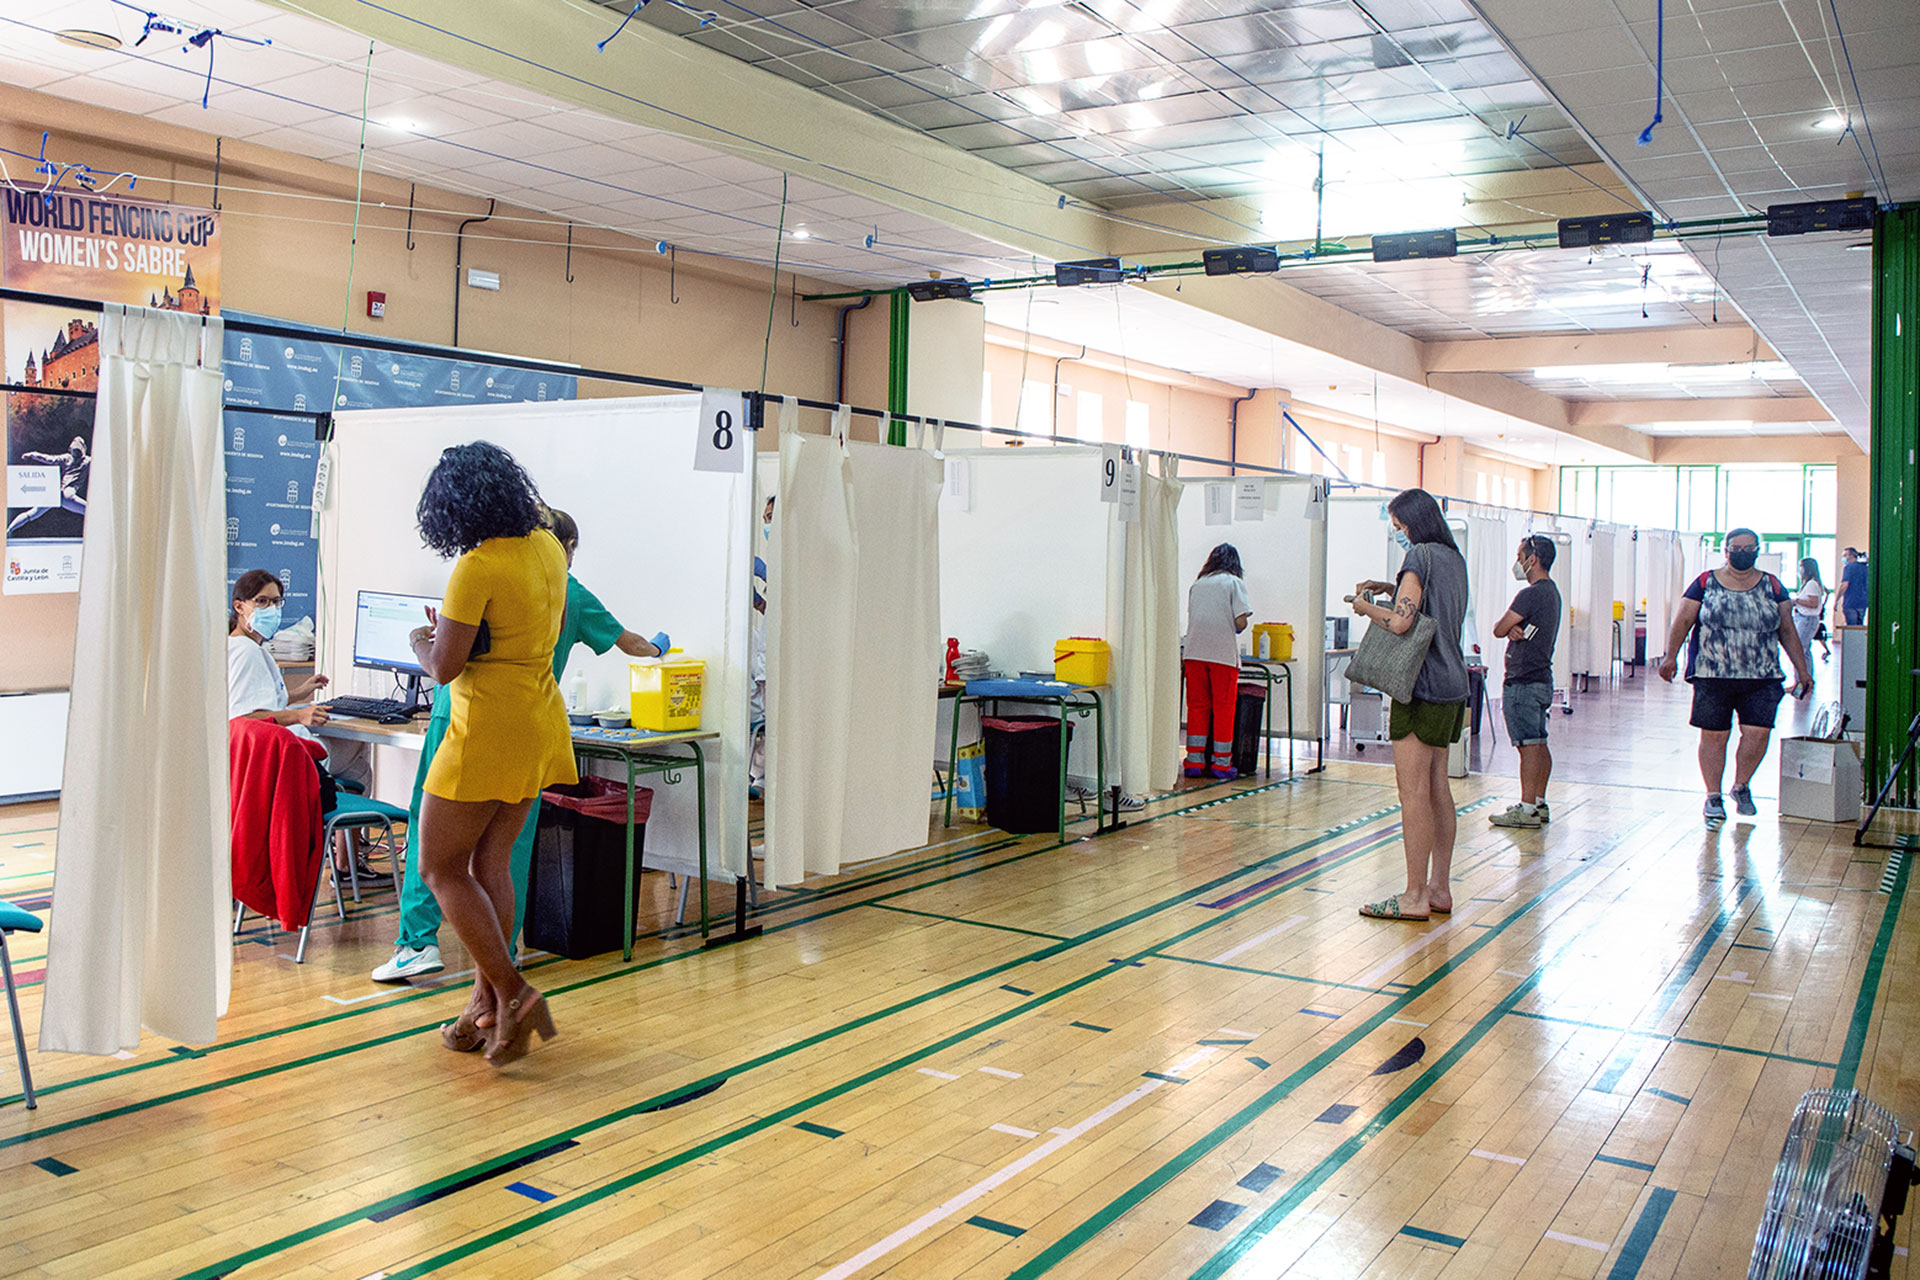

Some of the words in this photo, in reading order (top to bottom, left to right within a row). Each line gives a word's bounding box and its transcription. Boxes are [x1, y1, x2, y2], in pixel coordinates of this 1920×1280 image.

[6, 189, 84, 231] WORLD
[88, 200, 173, 243] FENCING
[176, 212, 215, 247] CUP
[19, 229, 118, 271] WOMEN'S
[123, 241, 186, 277] SABRE
[713, 409, 733, 450] 8
[18, 471, 46, 479] SALIDA
[1105, 458, 1115, 487] 9
